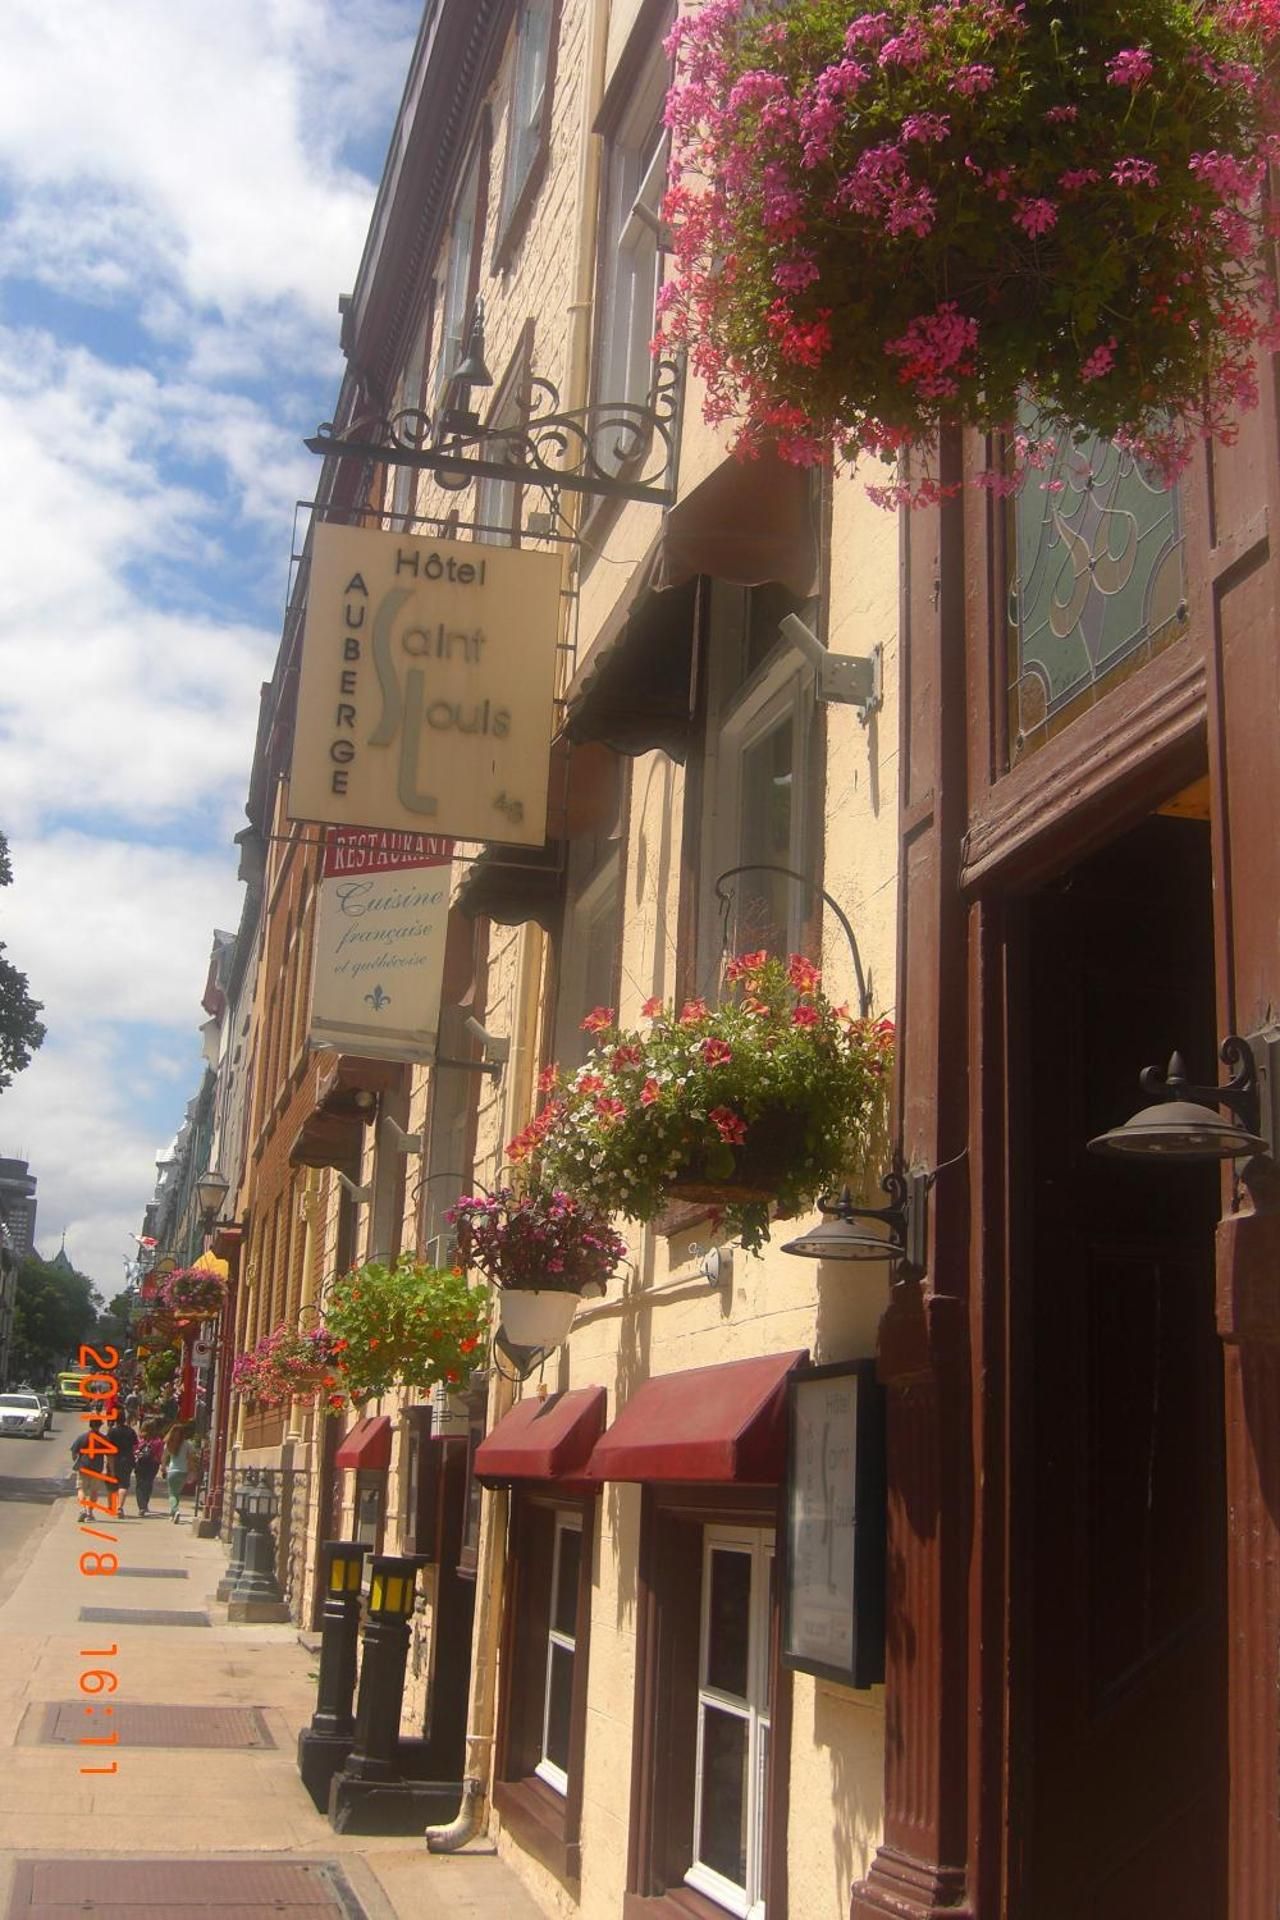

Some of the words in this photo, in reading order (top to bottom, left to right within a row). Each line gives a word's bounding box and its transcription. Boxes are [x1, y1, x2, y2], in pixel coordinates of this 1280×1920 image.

[395, 548, 487, 586] Hôtel
[328, 572, 369, 796] AUBERGE
[336, 881, 444, 917] Cuisine
[335, 920, 433, 954] française
